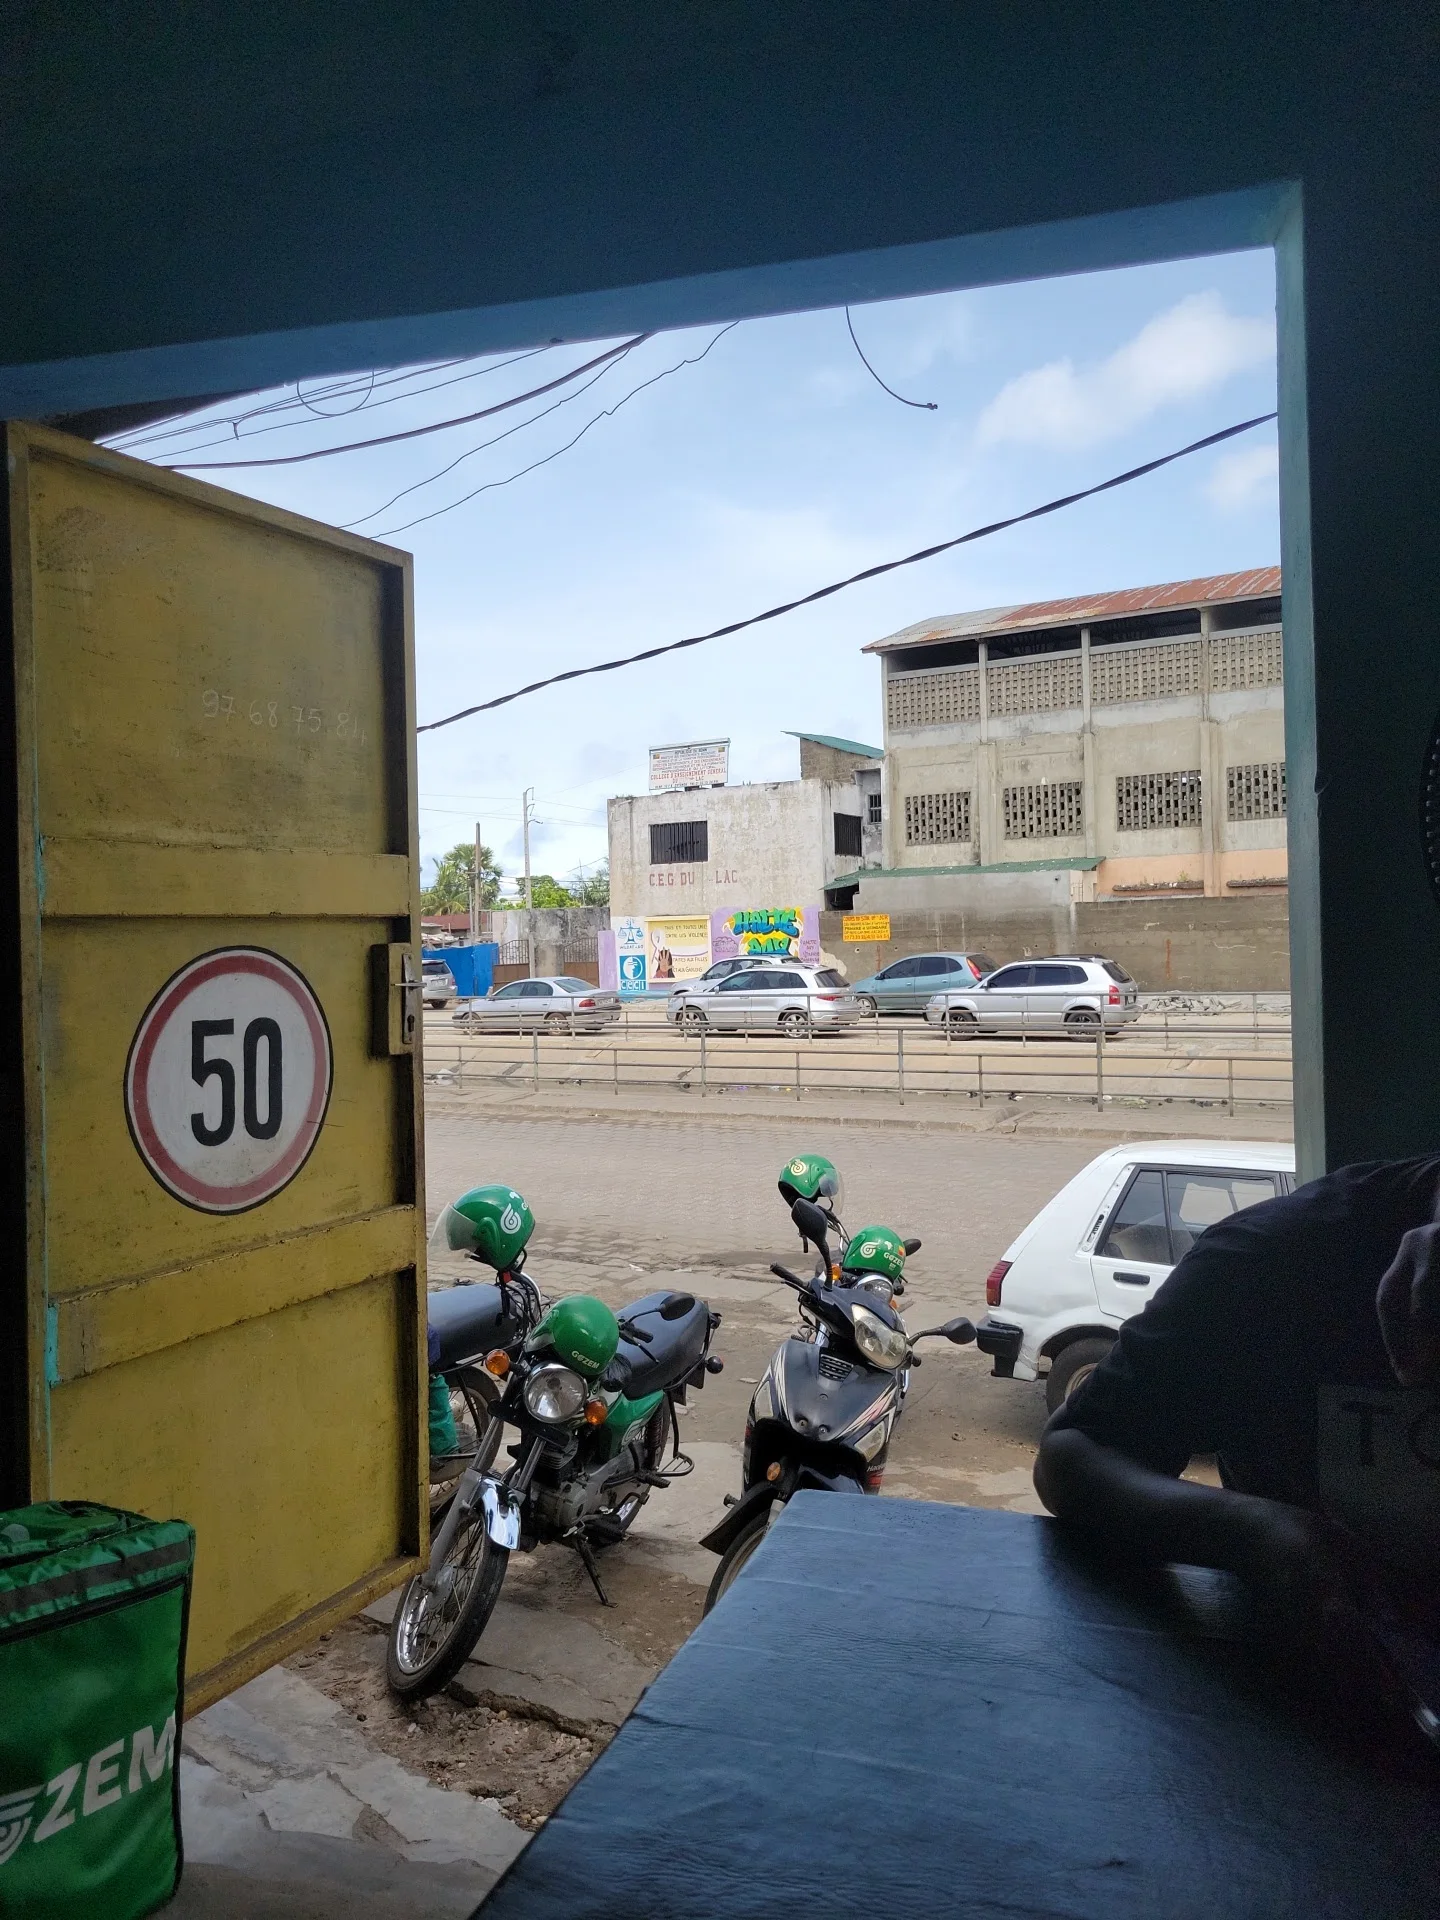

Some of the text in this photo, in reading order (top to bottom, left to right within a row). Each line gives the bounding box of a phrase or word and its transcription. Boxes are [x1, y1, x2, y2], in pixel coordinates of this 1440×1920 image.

[249, 699, 278, 728] 68
[291, 705, 323, 733] 75
[680, 872, 695, 886] DU
[715, 869, 738, 883] LAC
[733, 907, 799, 938] HALTE
[190, 1017, 283, 1147] 50
[571, 1350, 601, 1369] GOZEM
